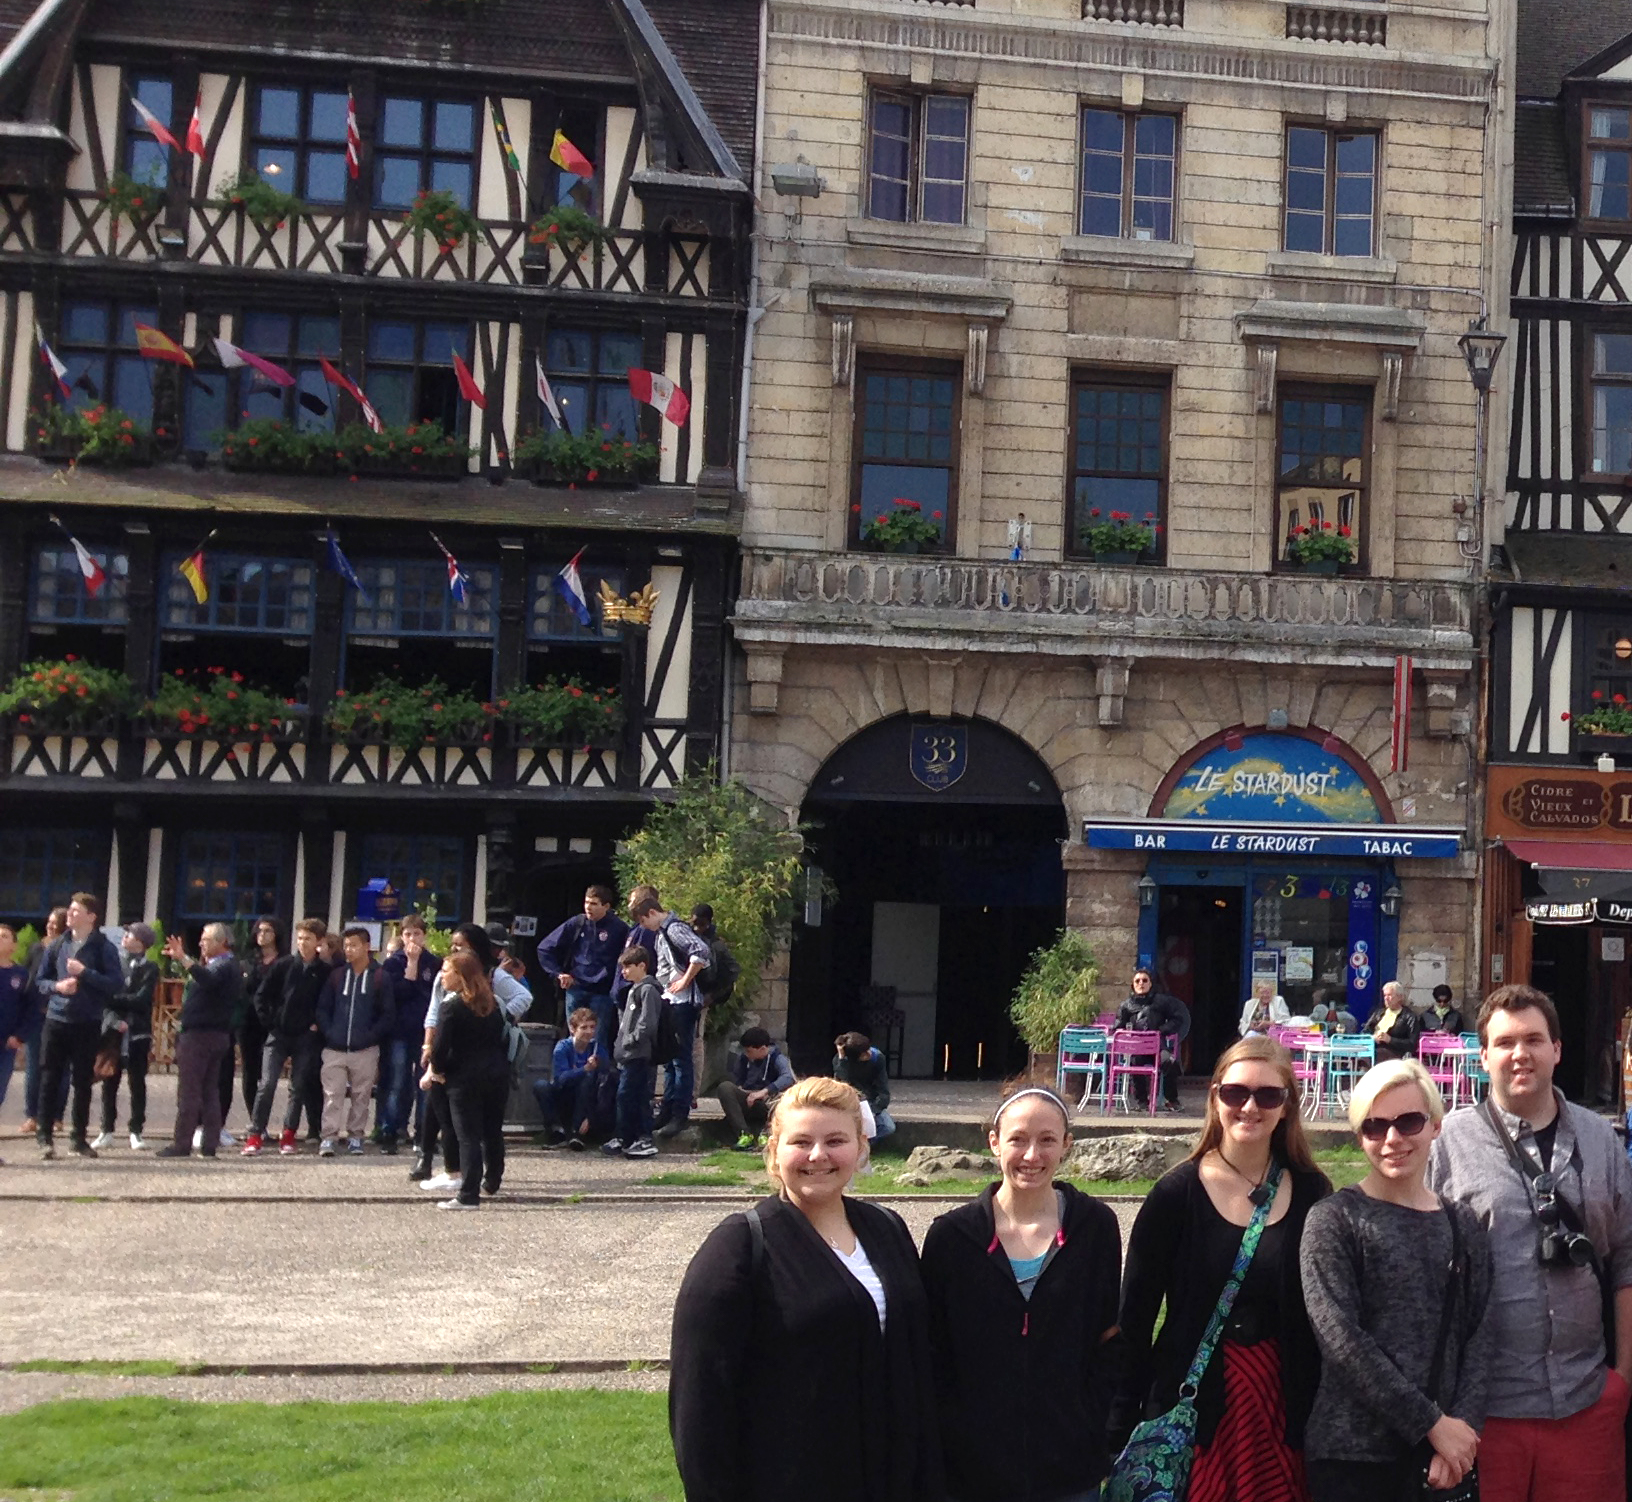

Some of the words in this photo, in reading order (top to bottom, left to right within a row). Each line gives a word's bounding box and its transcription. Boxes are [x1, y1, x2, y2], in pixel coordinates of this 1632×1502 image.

[921, 735, 957, 763] 33
[1194, 765, 1228, 793] LE
[1232, 769, 1332, 797] STARDUST
[1134, 834, 1166, 849] BAR
[1211, 835, 1234, 850] LE
[1235, 836, 1320, 852] STARDUST
[1363, 840, 1413, 855] TABAC
